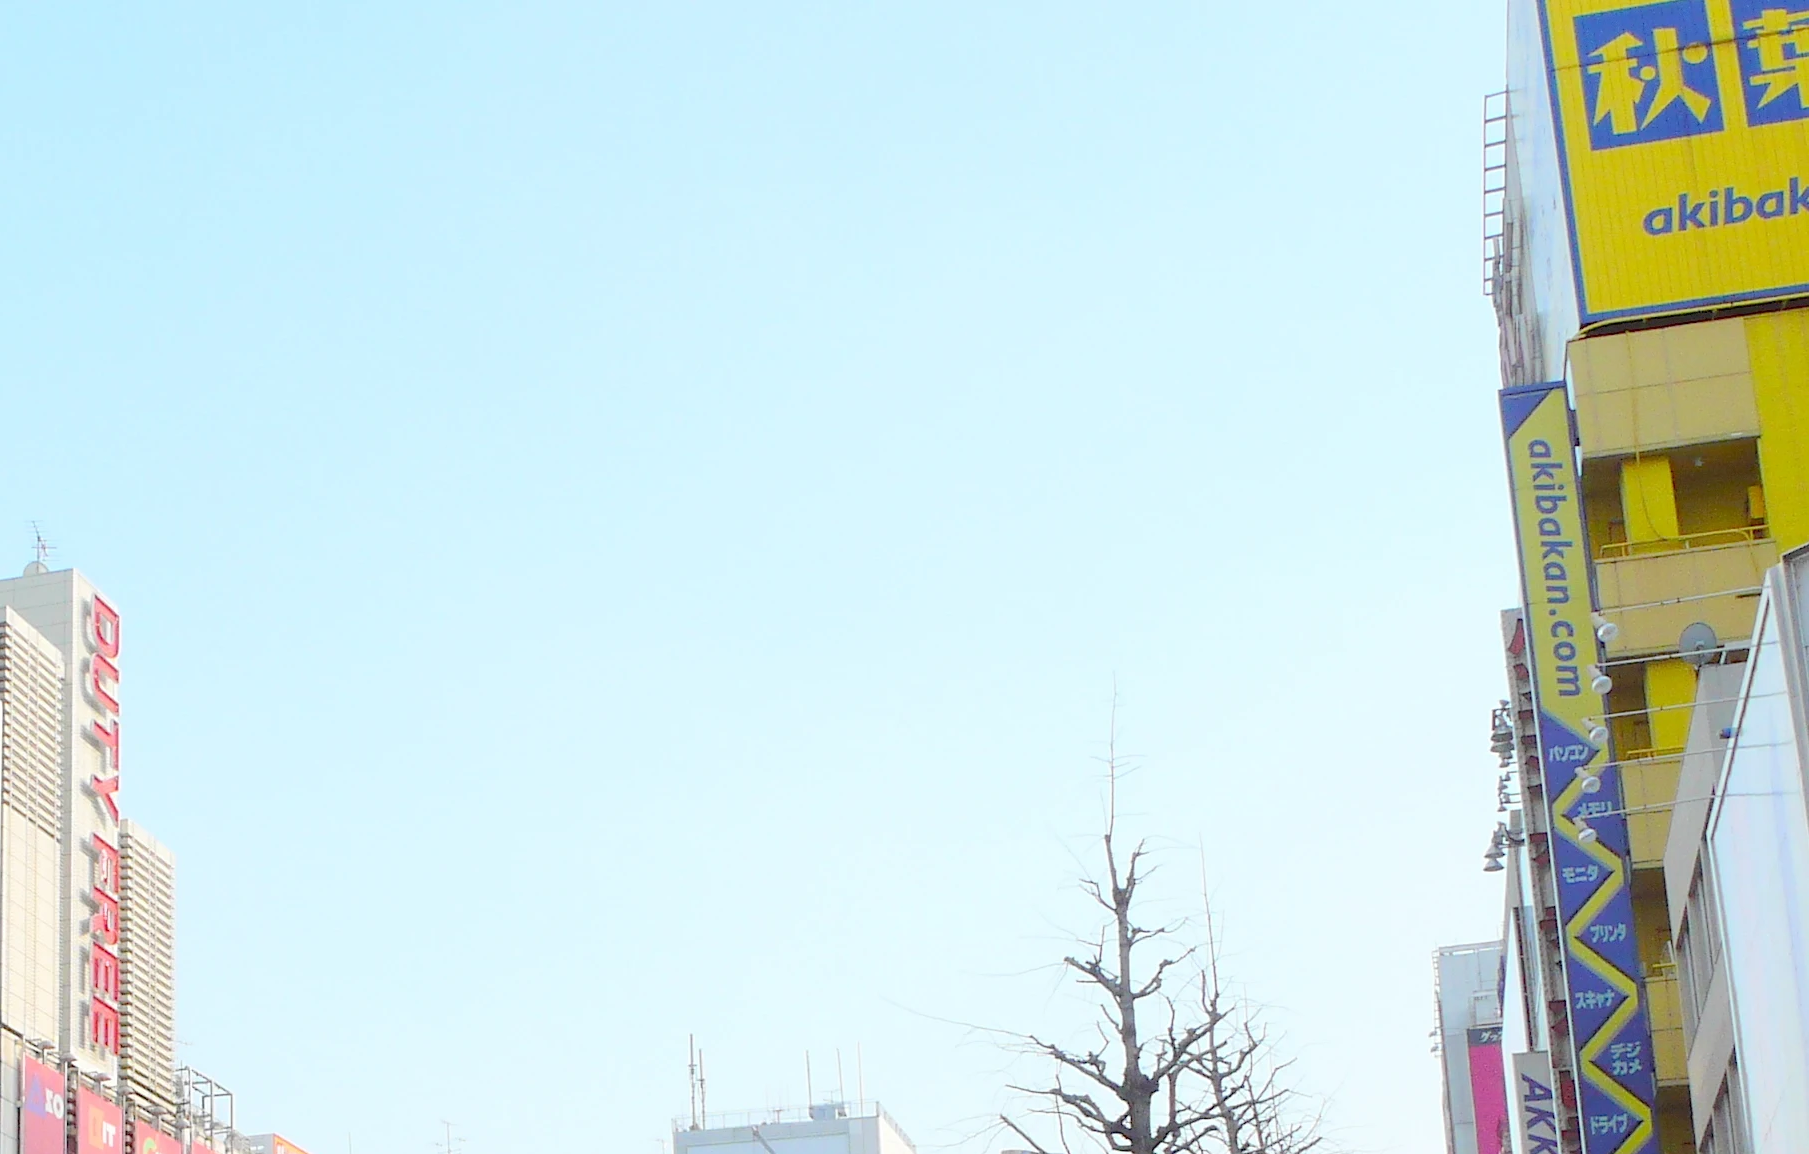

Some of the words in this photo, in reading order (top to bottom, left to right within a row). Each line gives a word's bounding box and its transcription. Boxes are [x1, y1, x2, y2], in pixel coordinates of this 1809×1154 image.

[1528, 438, 1581, 698] akibakan.com
[91, 594, 120, 828] DUTY
[91, 831, 120, 1058] FREE
